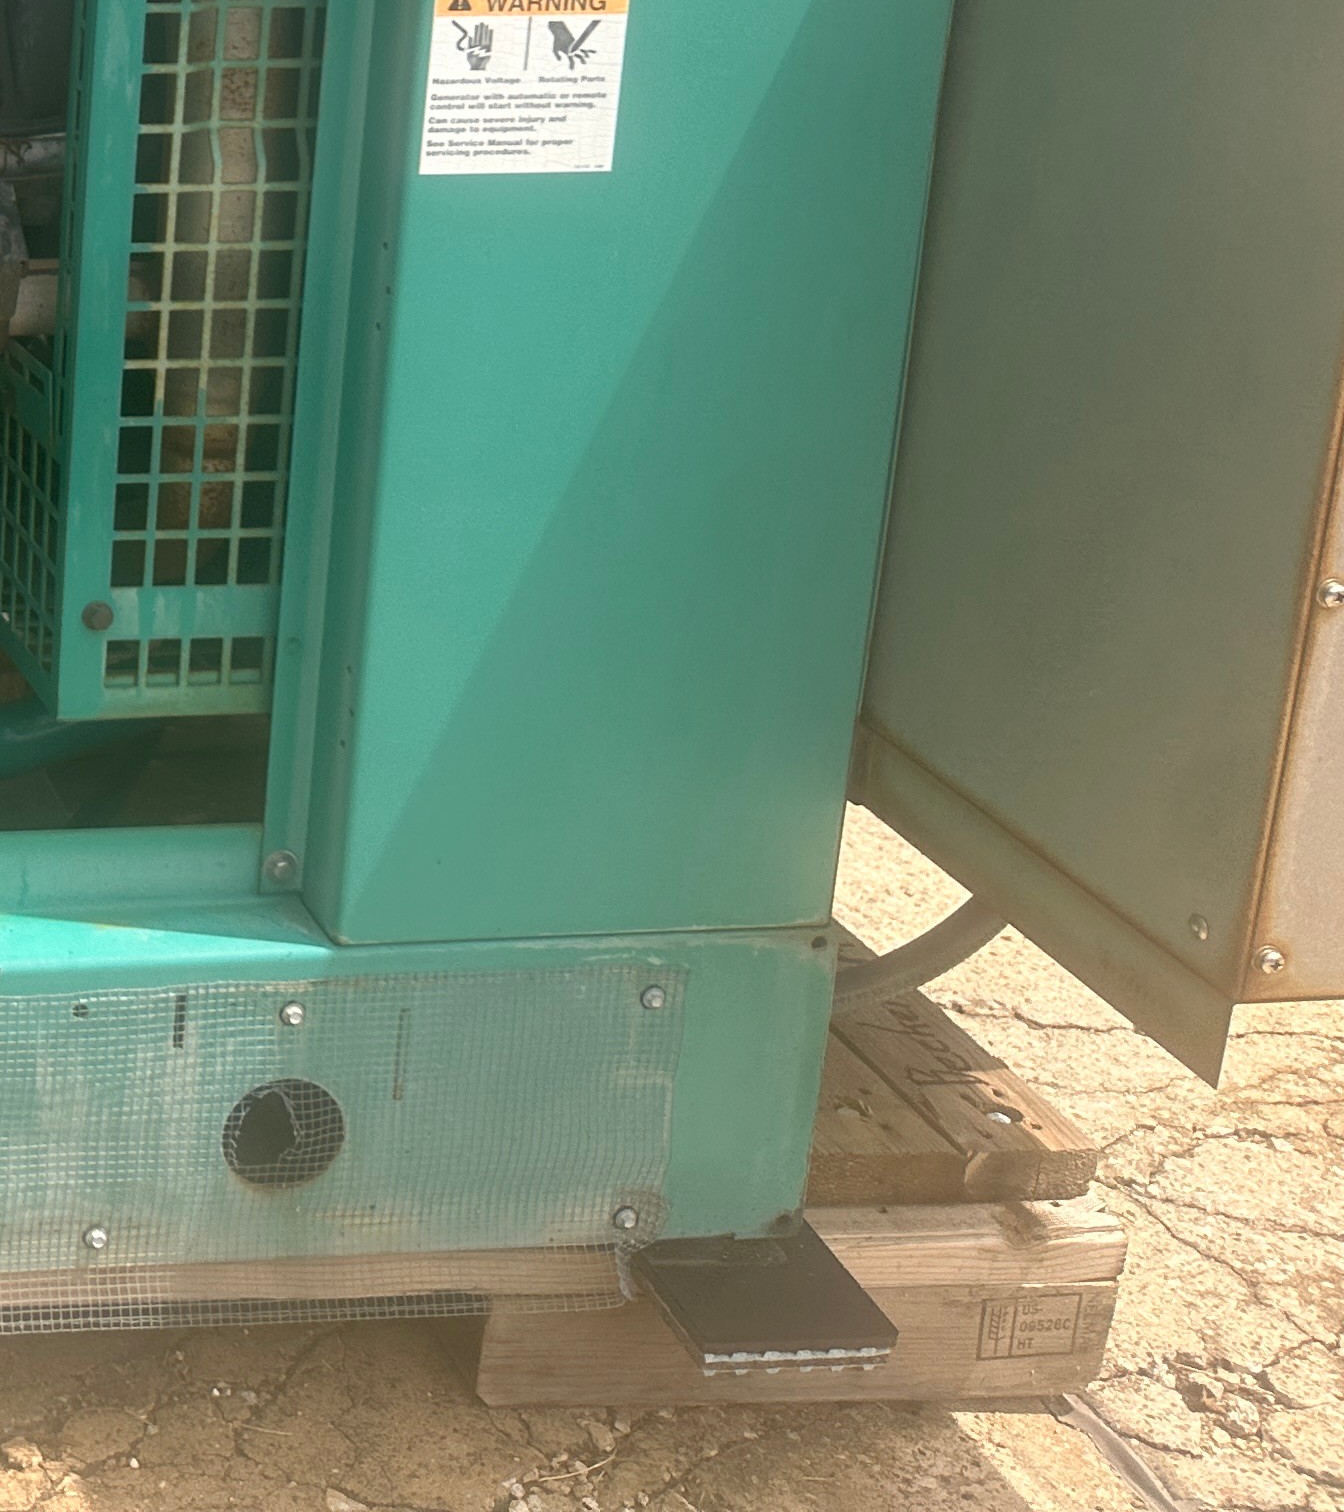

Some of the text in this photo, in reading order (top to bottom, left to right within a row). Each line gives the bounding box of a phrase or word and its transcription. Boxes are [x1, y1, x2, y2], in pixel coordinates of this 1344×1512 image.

[432, 77, 521, 85] Hazardous Voltage
[538, 75, 606, 84] Rotating Parts
[431, 93, 480, 101] Generator
[507, 92, 557, 100] automatic
[468, 102, 485, 110] will
[514, 101, 552, 109] without
[554, 102, 596, 110] warning.
[428, 117, 448, 125] Can
[450, 117, 480, 125] cause
[518, 116, 546, 124] injury
[548, 115, 568, 123] and
[427, 126, 467, 134] damage
[482, 125, 537, 134] equipment.
[426, 138, 574, 147] See Service Manual for proper
[426, 148, 531, 157] servicing procedures.
[1017, 1337, 1034, 1351] HT
